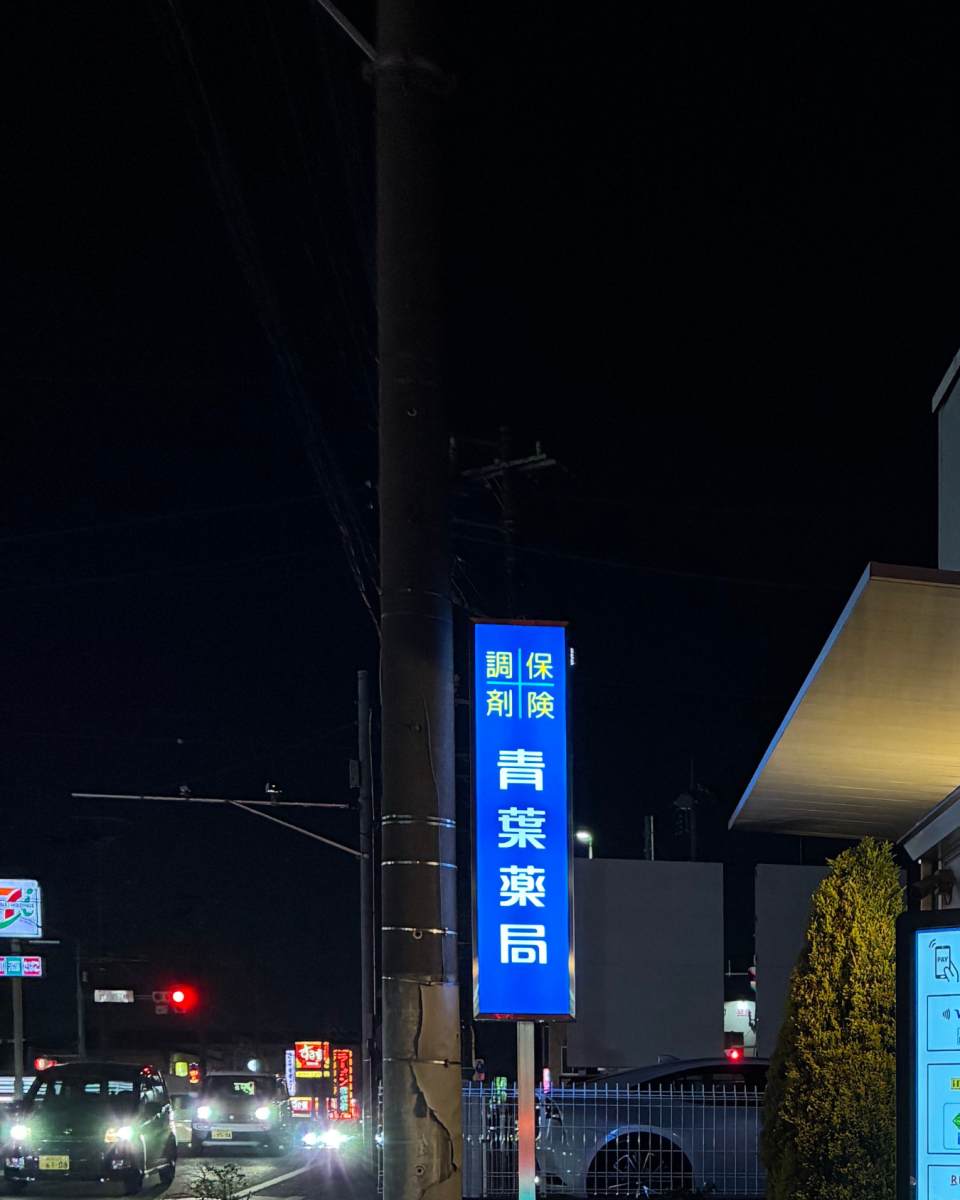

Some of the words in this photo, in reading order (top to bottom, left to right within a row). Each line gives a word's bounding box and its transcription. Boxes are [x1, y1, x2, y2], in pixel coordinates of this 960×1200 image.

[486, 651, 513, 718] 調剤
[526, 651, 555, 719] 保険
[497, 749, 548, 964] 青葉薬局
